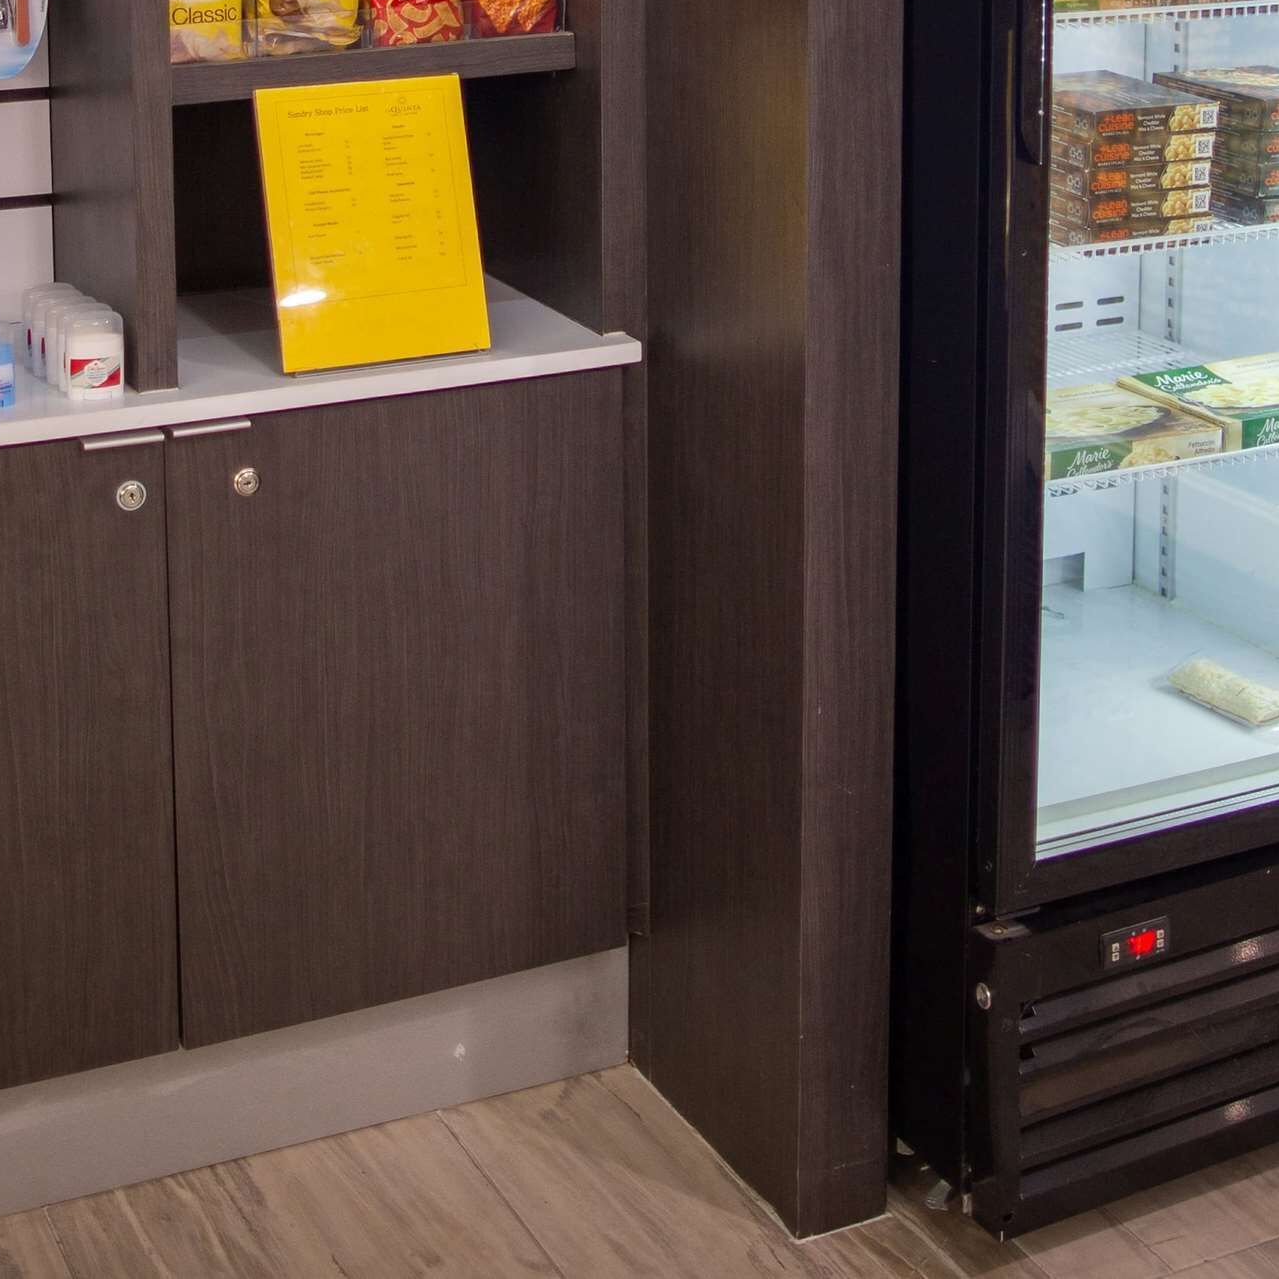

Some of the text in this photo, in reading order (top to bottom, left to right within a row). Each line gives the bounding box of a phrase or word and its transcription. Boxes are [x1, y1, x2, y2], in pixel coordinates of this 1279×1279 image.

[172, 5, 237, 27] Classic
[315, 108, 333, 117] Shop
[334, 107, 354, 115] Price
[356, 104, 369, 113] List
[1154, 369, 1208, 388] Marie
[1071, 447, 1111, 469] Marie
